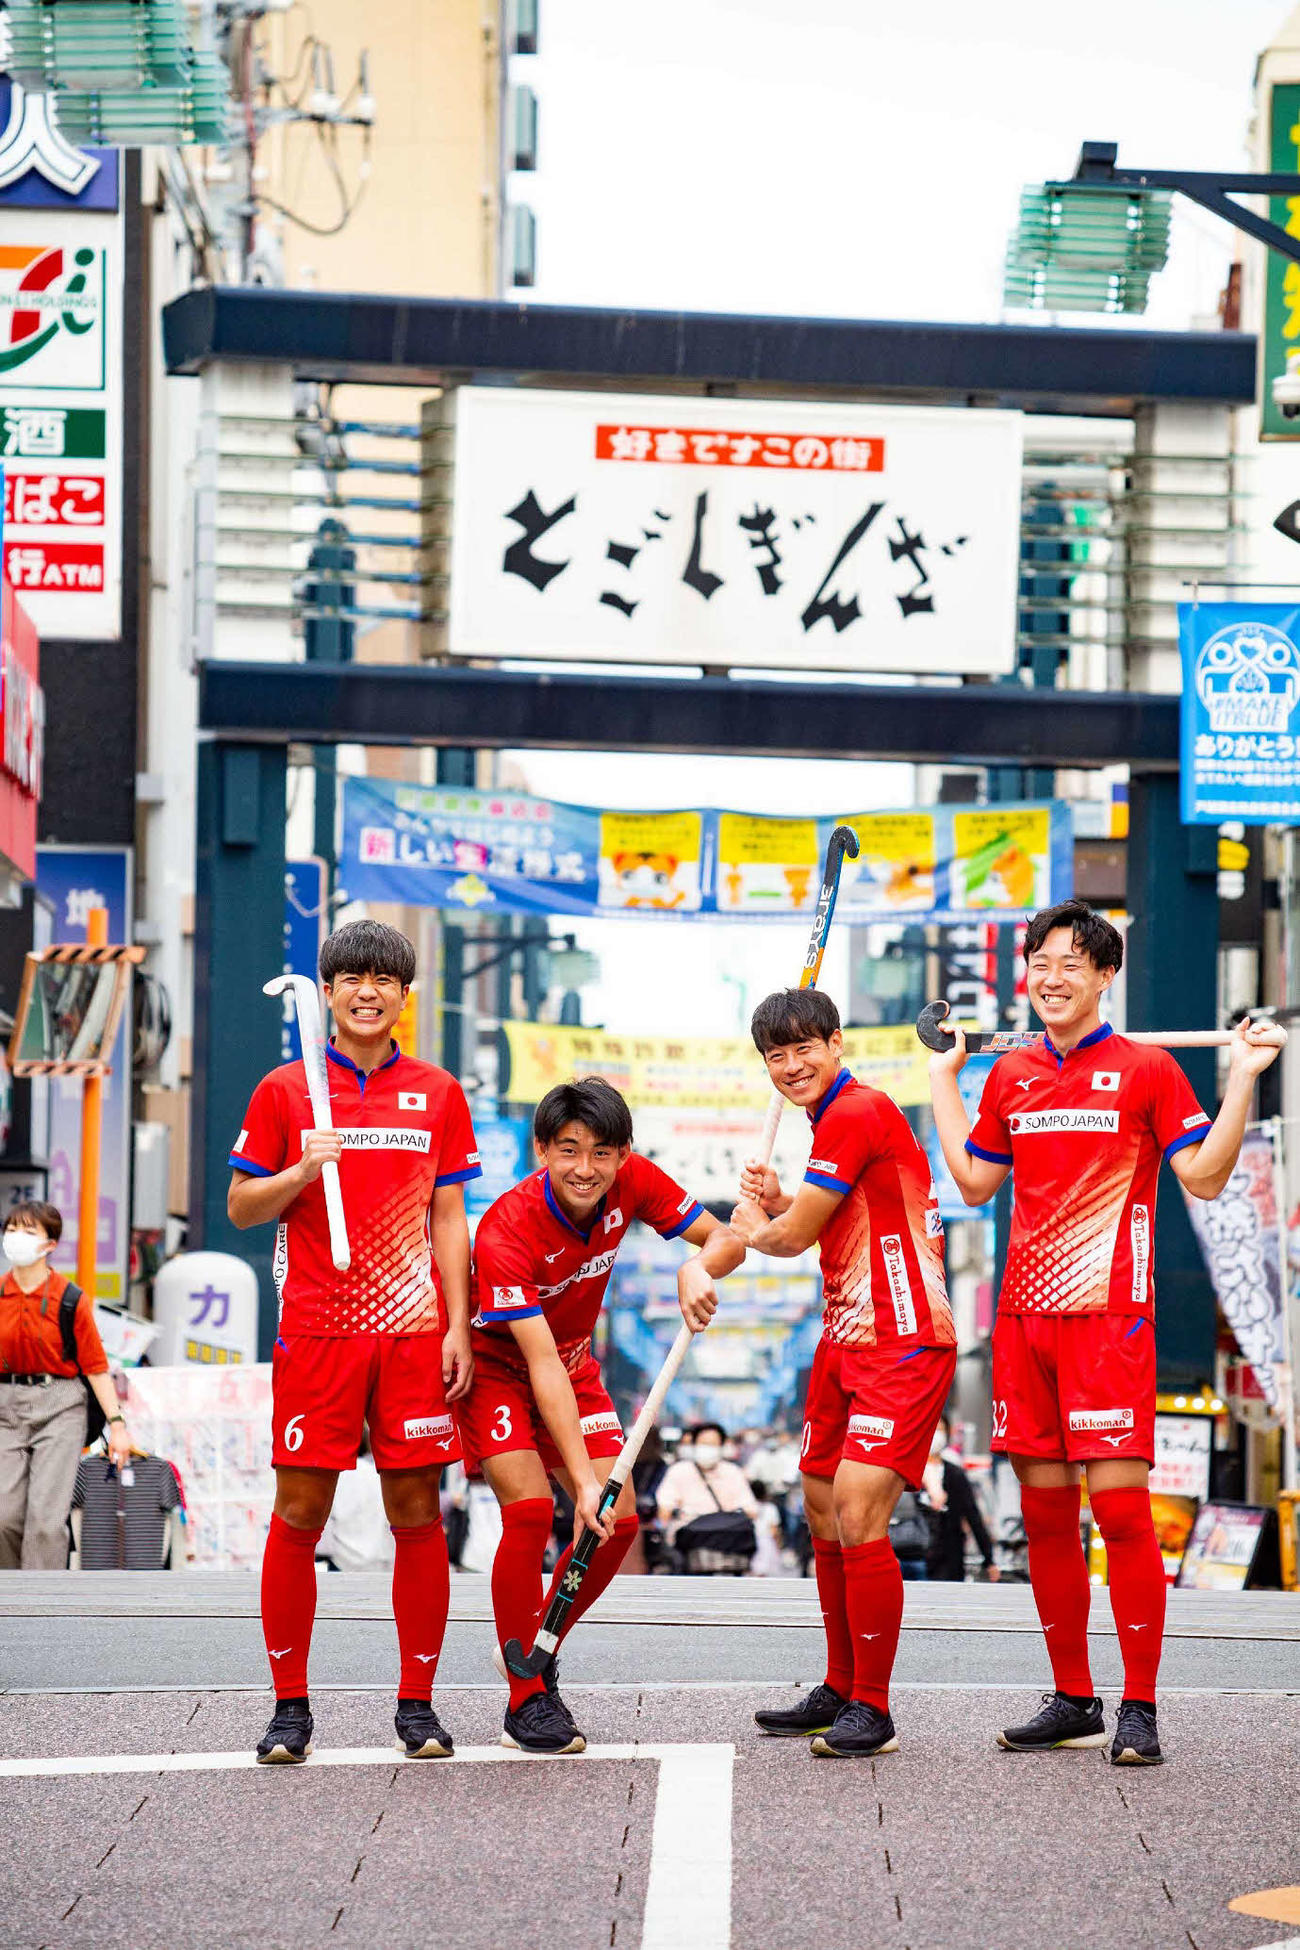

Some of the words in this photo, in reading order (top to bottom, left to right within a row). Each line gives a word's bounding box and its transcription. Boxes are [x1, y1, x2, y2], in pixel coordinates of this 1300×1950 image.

[3, 407, 68, 457] 酒
[608, 426, 872, 471] 好きですこの街
[4, 476, 103, 525] ばこ
[501, 487, 969, 633] とごしぎんざ
[338, 1132, 380, 1146] OMPO
[381, 1133, 427, 1149] JAPAN
[1025, 1114, 1070, 1130] SOMPO
[1069, 1114, 1115, 1129] JAPAN
[277, 1224, 287, 1265] CARE
[1133, 1224, 1147, 1300] Takashimaya
[888, 1255, 909, 1334] Takashimaya
[283, 1413, 307, 1452] 6
[489, 1404, 513, 1442] 3
[1070, 1414, 1127, 1430] kikkoman
